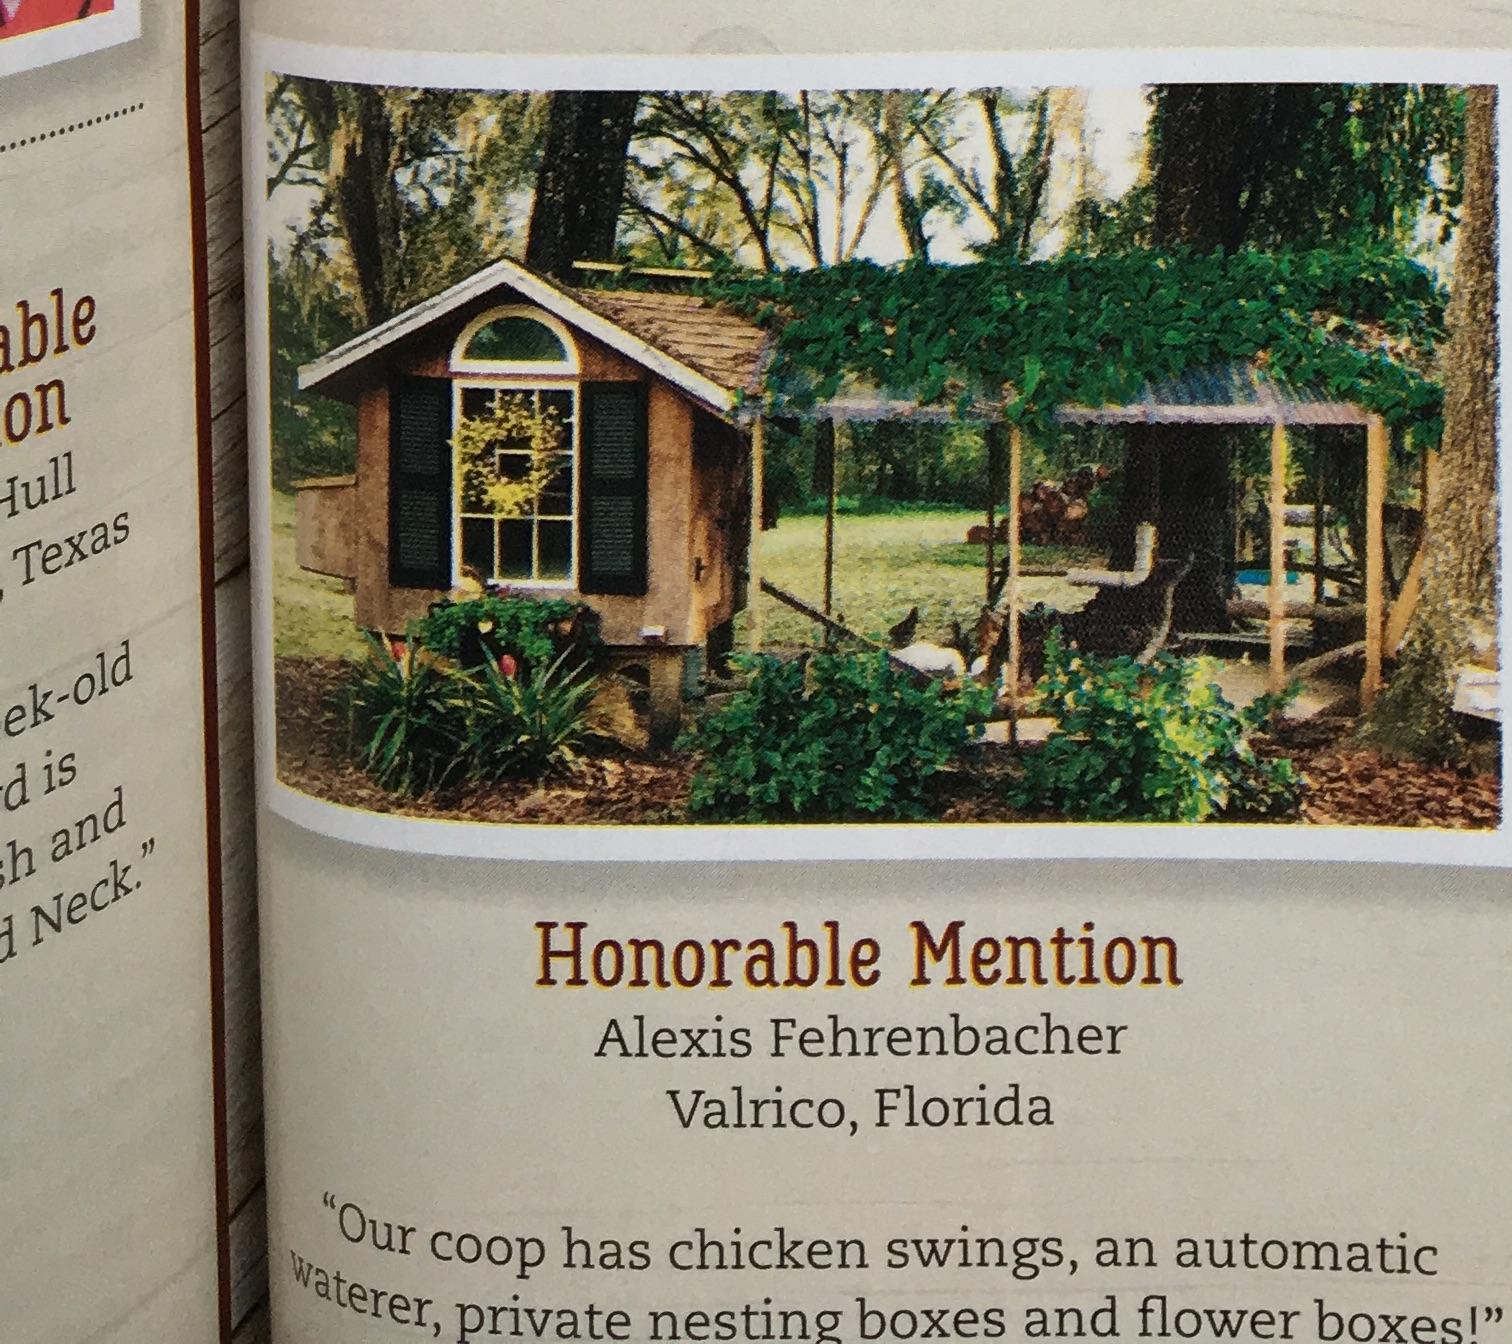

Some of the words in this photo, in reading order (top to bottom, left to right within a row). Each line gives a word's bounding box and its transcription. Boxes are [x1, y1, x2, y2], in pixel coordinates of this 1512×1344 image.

[0, 378, 71, 447] on
[12, 511, 131, 586] Texas
[0, 640, 133, 738] ek-old
[43, 750, 77, 795] is
[50, 785, 126, 862] and
[31, 837, 156, 946] Neck.”
[535, 920, 881, 988] Honorable
[910, 920, 1183, 986] Mention
[594, 1015, 752, 1058] Alexis
[770, 1012, 1128, 1057] Fehrenbacher
[665, 1085, 858, 1136] Valrico,
[875, 1083, 1054, 1127] Florida
[323, 1191, 416, 1255] “Our
[430, 1231, 545, 1280] coop
[561, 1226, 651, 1270] has
[669, 1227, 869, 1270] chicken
[887, 1225, 1078, 1280] swings,
[1096, 1237, 1157, 1267] an
[1176, 1232, 1438, 1276] automatic
[291, 1250, 441, 1338] waterer,
[456, 1295, 632, 1344] private
[648, 1298, 842, 1344] nesting
[855, 1297, 1005, 1340] boxes
[1025, 1295, 1120, 1337] and
[1138, 1295, 1301, 1339] flower
[1313, 1298, 1503, 1344] boxes!”
